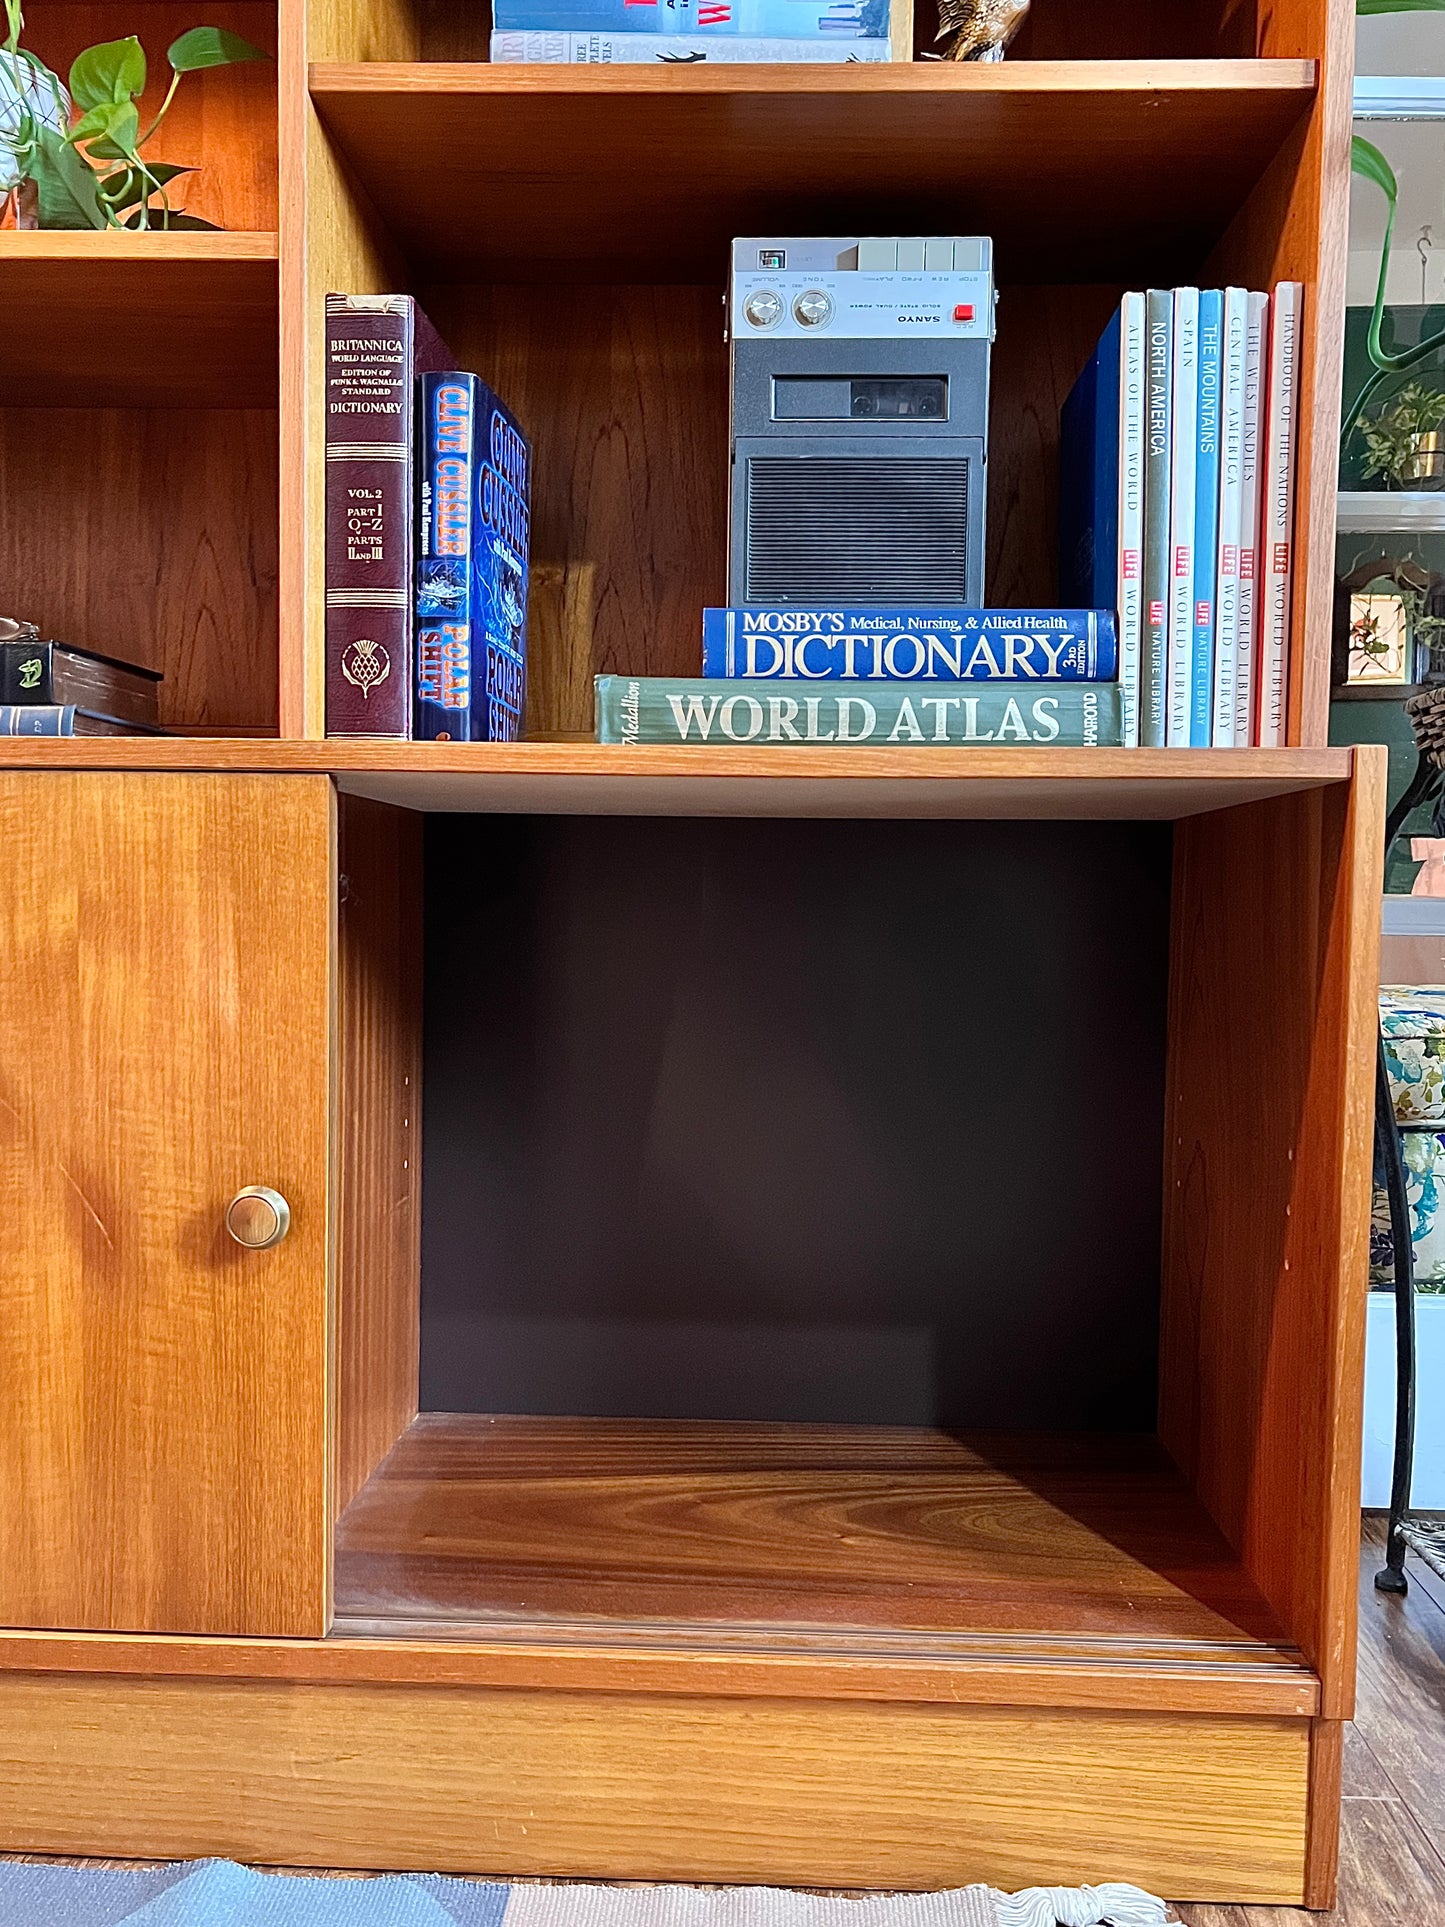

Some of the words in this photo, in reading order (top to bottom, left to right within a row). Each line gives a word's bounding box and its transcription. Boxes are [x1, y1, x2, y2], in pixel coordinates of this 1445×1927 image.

[331, 340, 404, 351] BRITANNICA
[331, 355, 359, 363] WORLD
[361, 355, 404, 363] LANGUAGE
[1128, 324, 1139, 374] ATLAS
[1152, 322, 1167, 378] NORTH
[1183, 319, 1193, 367] SPAIN
[1202, 324, 1218, 355] THE
[1229, 316, 1241, 395] CENTRAL
[1248, 323, 1260, 356] THE
[1281, 313, 1295, 397] HANDBOOK
[330, 402, 403, 413] DICTIONARY
[1128, 383, 1138, 405] OF
[1200, 362, 1217, 454] MOUNTAINS
[1245, 366, 1258, 411] WEST
[438, 387, 470, 453] CLIVE
[1128, 413, 1138, 443] THE
[1150, 384, 1166, 457] AMERICA
[1280, 405, 1292, 424] OF
[1227, 408, 1239, 485] AMERICA
[1244, 422, 1256, 481] INDIES
[1279, 434, 1290, 460] THE
[375, 489, 382, 499] 2
[422, 481, 431, 498] with
[1127, 452, 1138, 511] WORLD
[1277, 465, 1290, 527] NATIONS
[347, 508, 375, 516] PART
[377, 504, 382, 516] I
[422, 499, 431, 516] Paul
[437, 459, 468, 556] CUSSLER
[348, 536, 382, 544] PARTS
[1177, 547, 1189, 576] LIFE
[1223, 545, 1236, 573] LIFE
[1275, 545, 1288, 573] LIFE
[1125, 551, 1138, 579] LIFE
[1241, 550, 1253, 578] LIFE
[743, 612, 844, 632] MOSBY'S
[850, 617, 904, 631] Medical,
[908, 617, 962, 632] Nursing,
[965, 617, 979, 630] &
[983, 617, 1023, 629] Allied
[1024, 617, 1068, 630] Health
[1125, 589, 1137, 652] WORLD
[1151, 601, 1163, 625] LIFE
[1176, 586, 1188, 649] WORLD
[1197, 602, 1209, 625] LIFE
[1222, 584, 1235, 646] WORLD
[1239, 588, 1251, 651] WORLD
[1273, 583, 1286, 646] WORLD
[419, 631, 442, 701] SHIFT
[443, 624, 470, 709] POLAR
[742, 634, 1075, 678] DICTIONARY
[1062, 646, 1077, 668] 3RD
[1077, 639, 1087, 674] EDITION
[1152, 631, 1162, 674] NATURE
[1197, 631, 1208, 674] NATURE
[621, 682, 640, 746] Medallion
[1124, 664, 1136, 736] LIBRARY
[1151, 680, 1162, 726] LIBRARY
[1173, 661, 1186, 732] LIBRARY
[1196, 680, 1207, 726] LIBRARY
[1219, 659, 1232, 730] LIBRARY
[1236, 662, 1249, 734] LIBRARY
[1270, 659, 1283, 731] LIBRARY
[665, 694, 877, 742] WORLD
[886, 696, 1060, 742] ATLAS
